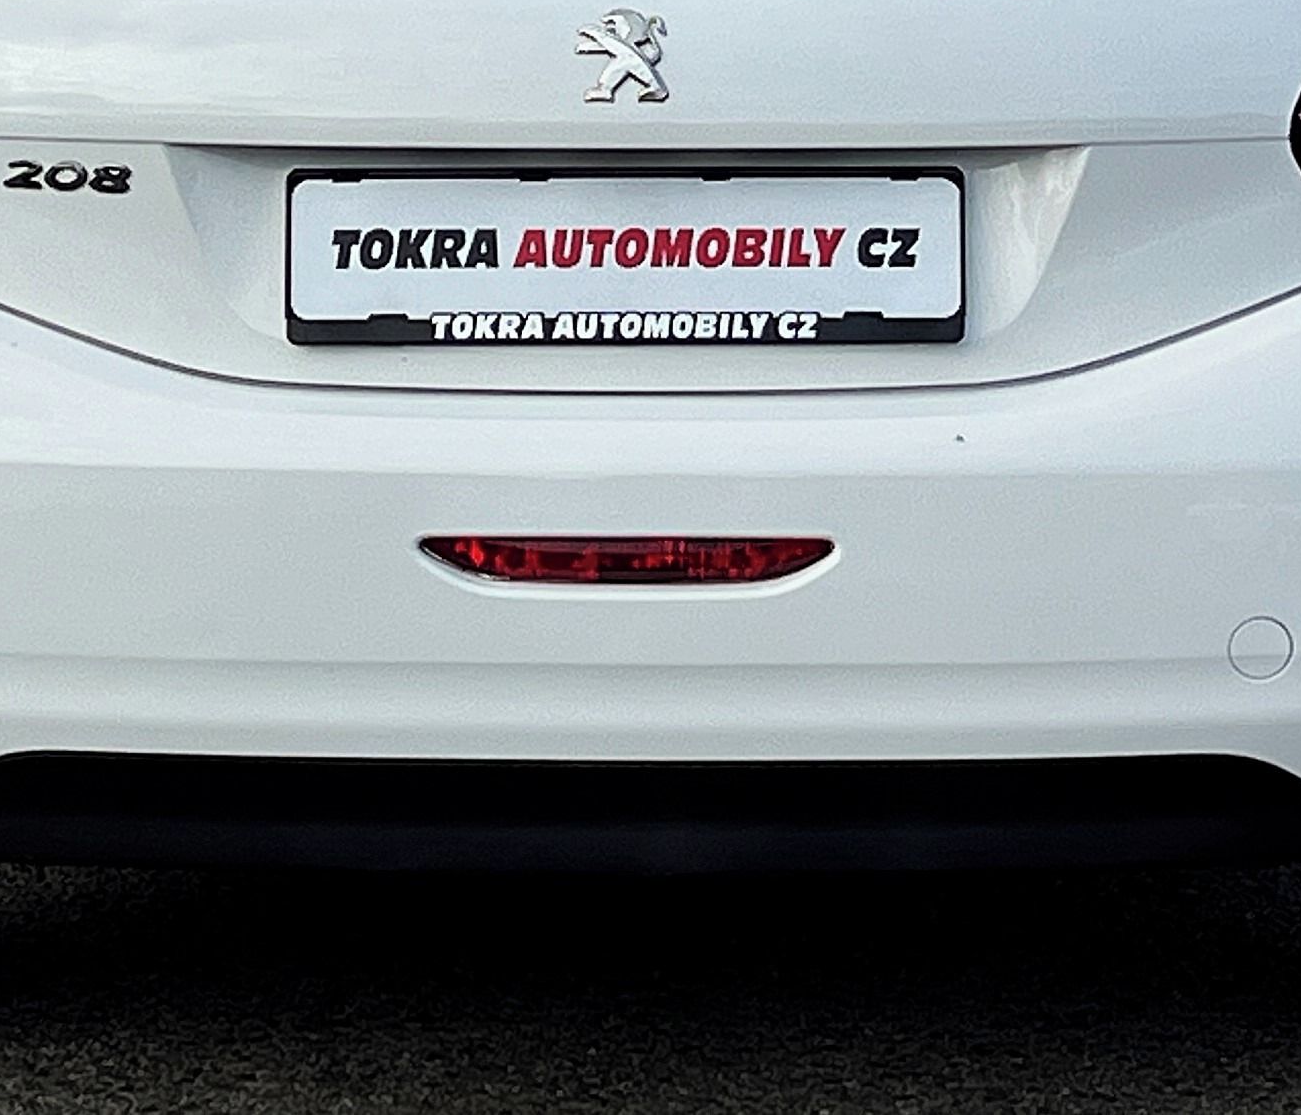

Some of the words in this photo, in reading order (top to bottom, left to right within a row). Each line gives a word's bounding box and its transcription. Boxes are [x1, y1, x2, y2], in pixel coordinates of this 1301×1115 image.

[3, 159, 133, 194] 208
[332, 228, 499, 270] TOKRA
[512, 227, 847, 269] AUTOMOBILY
[857, 227, 921, 269] CZ
[431, 313, 545, 340] TOKRA
[552, 313, 771, 340] AUTOMOBILY
[777, 313, 819, 340] CZ
